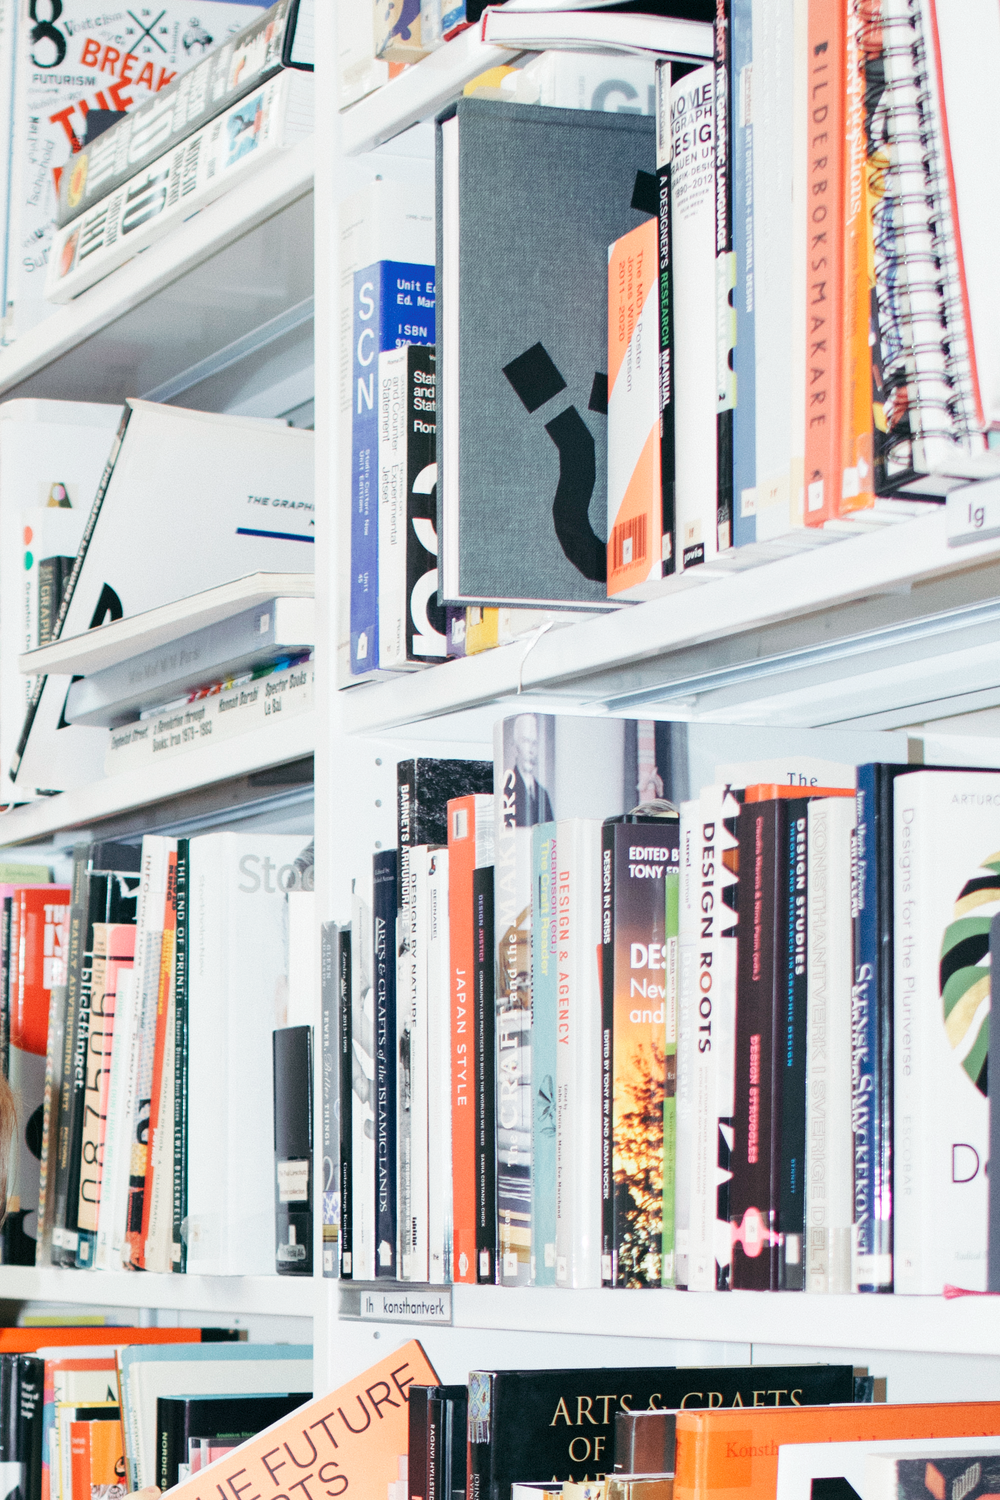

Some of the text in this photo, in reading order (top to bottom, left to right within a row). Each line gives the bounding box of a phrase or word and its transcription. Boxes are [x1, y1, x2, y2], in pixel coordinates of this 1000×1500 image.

[32, 74, 97, 86] FUTURISM
[397, 278, 421, 292] Unit
[634, 249, 644, 371] The MDT Poster
[659, 175, 671, 411] A DESIGNER'S RESEARCH MANUAL
[746, 272, 754, 313] DESIGN
[398, 323, 428, 338] ISBN
[626, 255, 635, 393] Jonas Williamson
[381, 377, 392, 443] Statement
[413, 386, 435, 398] and
[247, 495, 271, 507] THE
[388, 463, 400, 547] Experimental
[787, 772, 819, 787] The
[400, 783, 411, 843] BARNETS
[628, 865, 663, 879] TONY
[629, 847, 669, 862] EDITED
[789, 821, 797, 866] THEORY
[550, 838, 558, 916] Adamson
[603, 849, 612, 945] DESIGN IN CRISIS
[794, 817, 807, 976] DESIGN STUDIES
[175, 857, 186, 1000] THE END OF PRINT:
[540, 839, 550, 976] The Craft Reader
[788, 896, 796, 954] RESEARCH
[558, 870, 570, 1046] DESIGN AGENCY
[698, 822, 715, 1054] DESIGN ROOTS
[899, 807, 915, 1078] Designs for the Pluriverse
[630, 1003, 664, 1024] and
[787, 973, 795, 1022] GRAPHIC
[377, 918, 388, 1213] ARTS CRAFTS ISLAMIC LANDS
[456, 967, 468, 1107] JAPAN STYLE
[603, 1059, 610, 1071] BY
[786, 1025, 794, 1067] DESIGN
[747, 1033, 761, 1164] DESIGN STRUGGLES
[902, 1115, 912, 1196] ESCOBAR
[383, 1293, 445, 1315] konsthantverk
[260, 1362, 416, 1487] FUTURE
[549, 1393, 633, 1428] ARTS
[161, 1431, 169, 1476] NORDIC
[568, 1436, 606, 1463] OF
